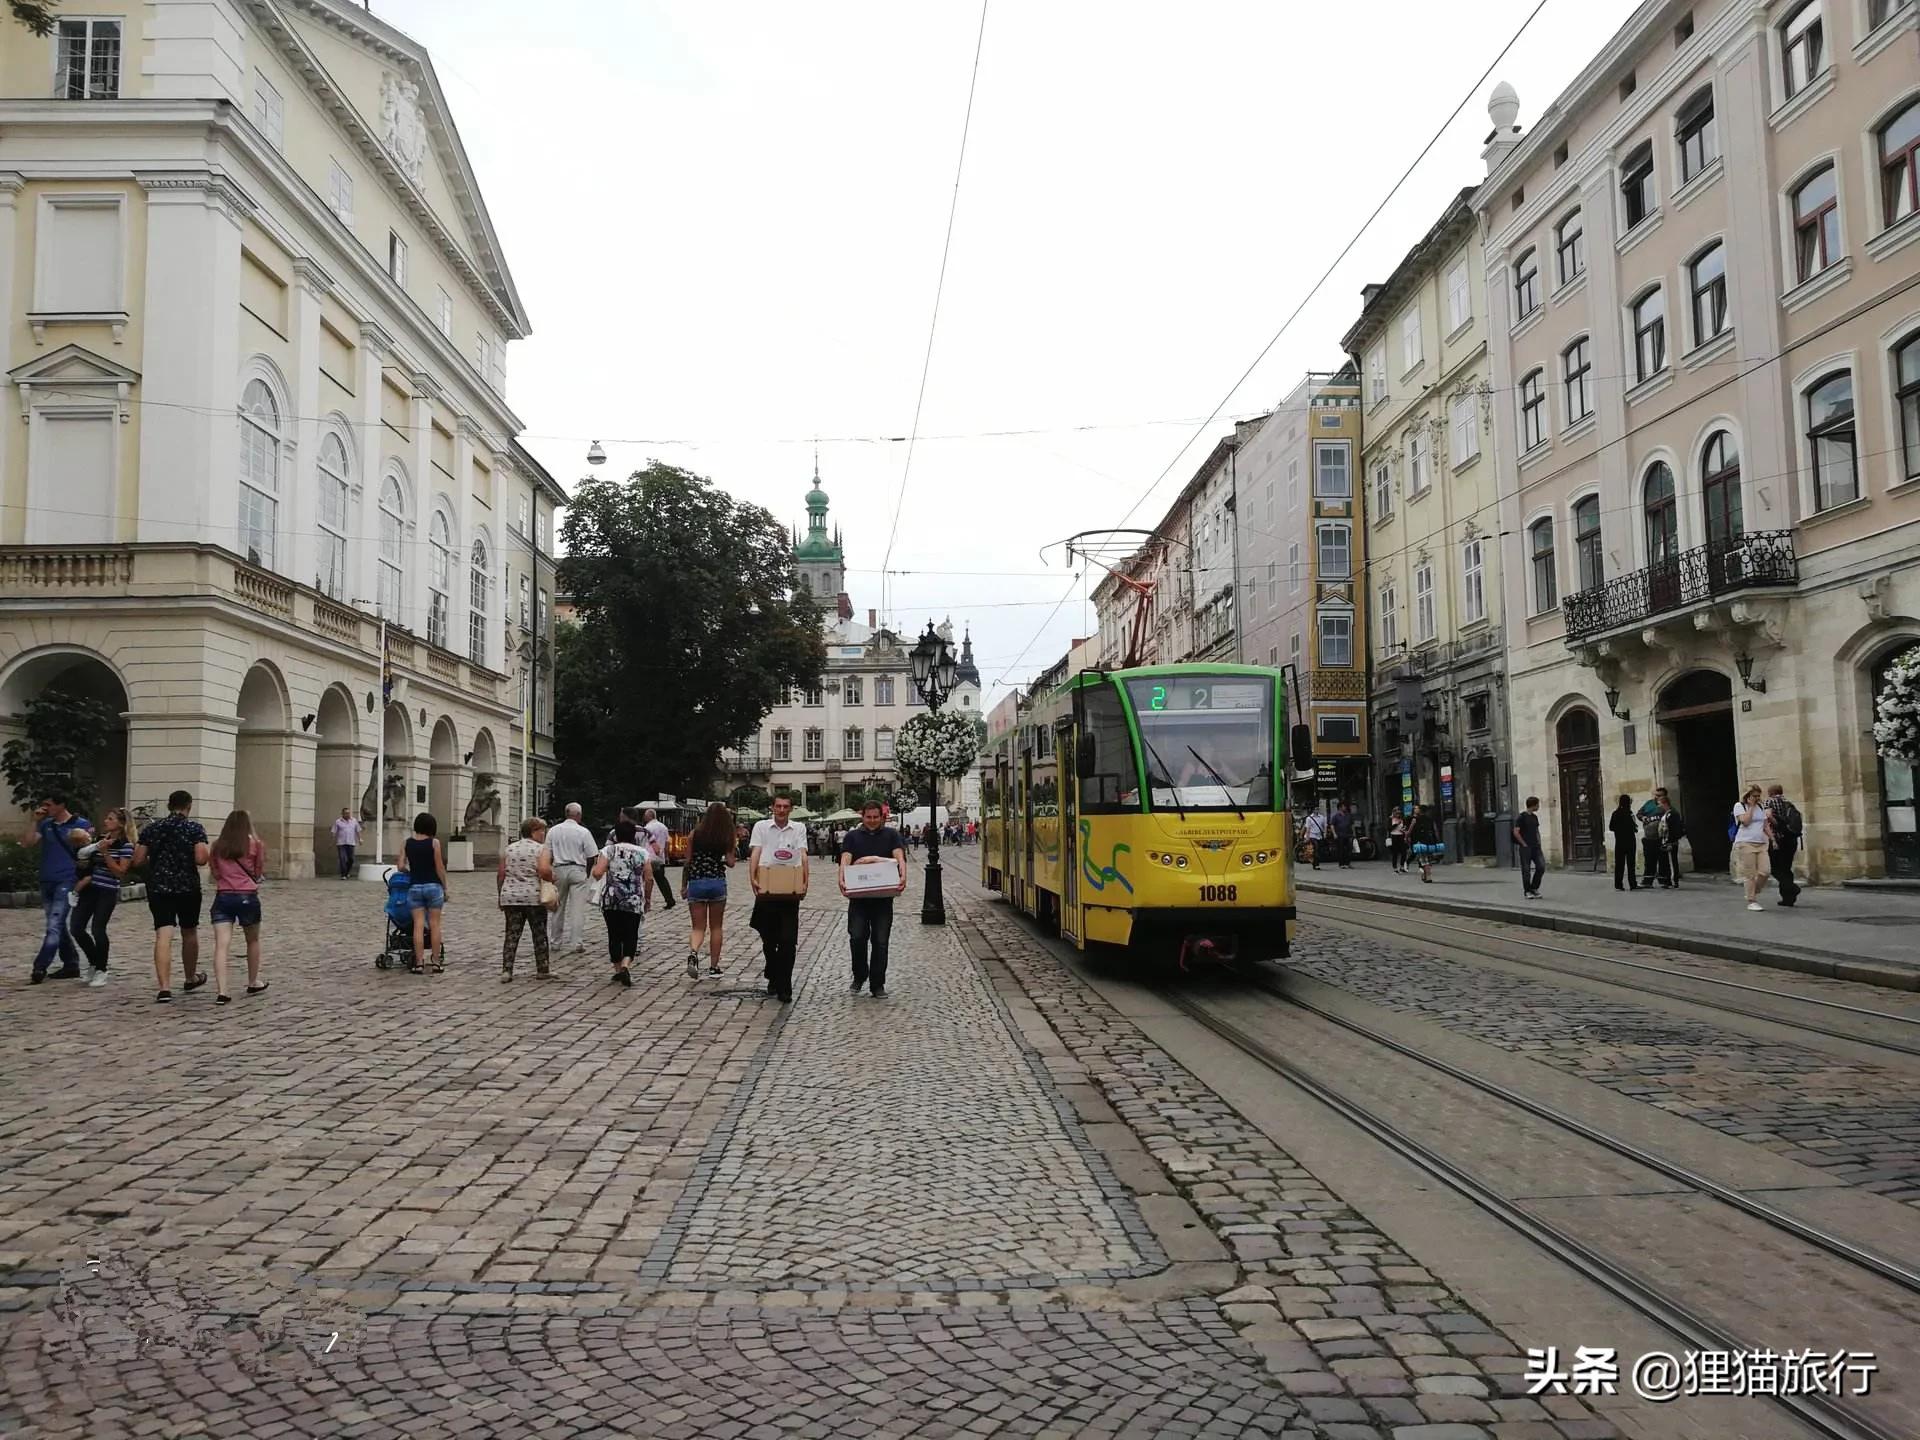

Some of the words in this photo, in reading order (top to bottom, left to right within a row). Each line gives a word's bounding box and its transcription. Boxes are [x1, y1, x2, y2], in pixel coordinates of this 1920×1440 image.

[1151, 686, 1166, 710] 2
[1194, 688, 1208, 709] 2
[1198, 885, 1237, 902] 1088
